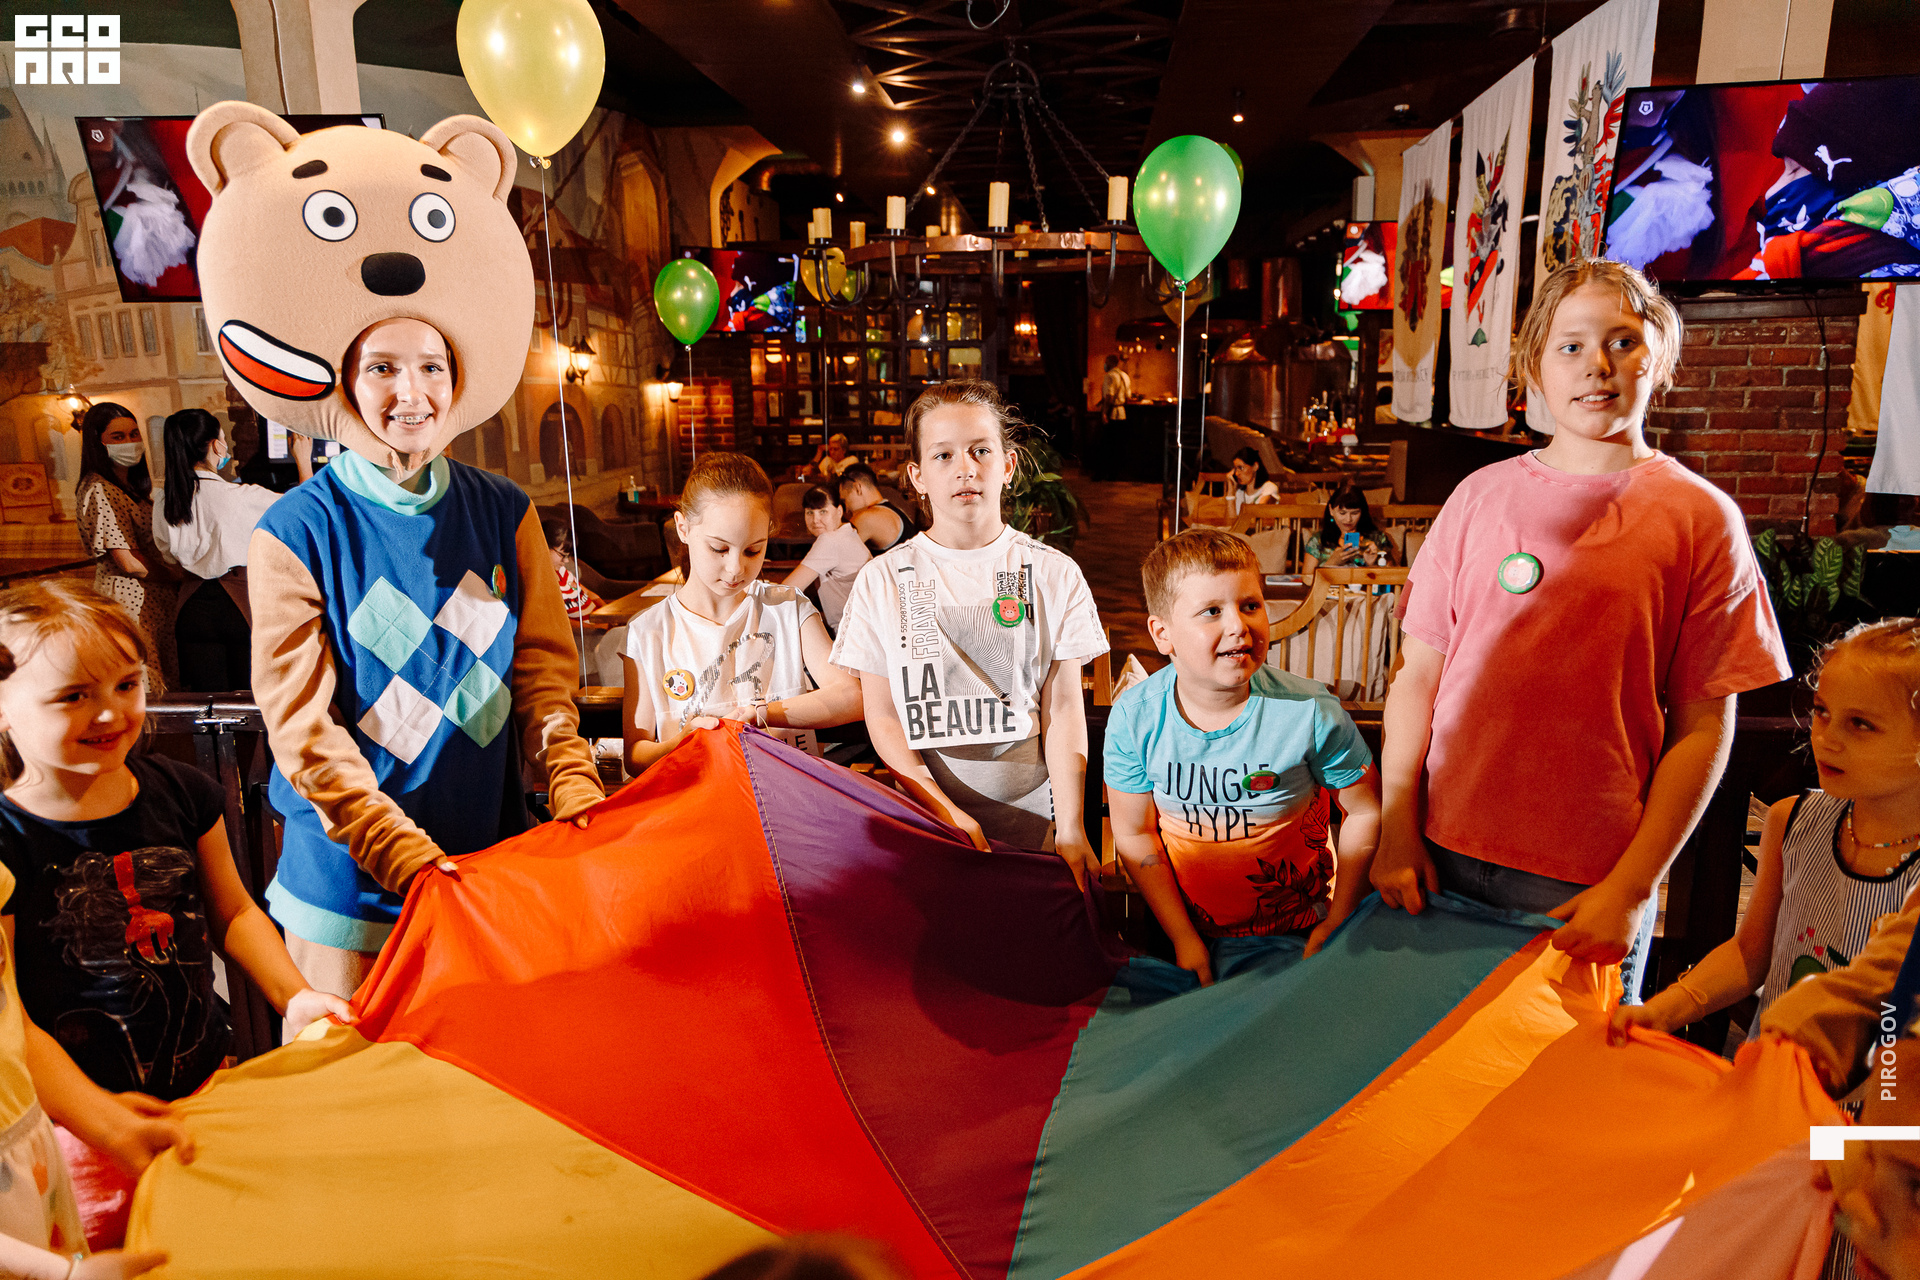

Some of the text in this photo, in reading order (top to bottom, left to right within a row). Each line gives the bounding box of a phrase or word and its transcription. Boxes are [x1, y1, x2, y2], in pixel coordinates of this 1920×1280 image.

[908, 579, 940, 660] FRANCE
[902, 663, 941, 703] LA
[1182, 803, 1256, 842] HYPE
